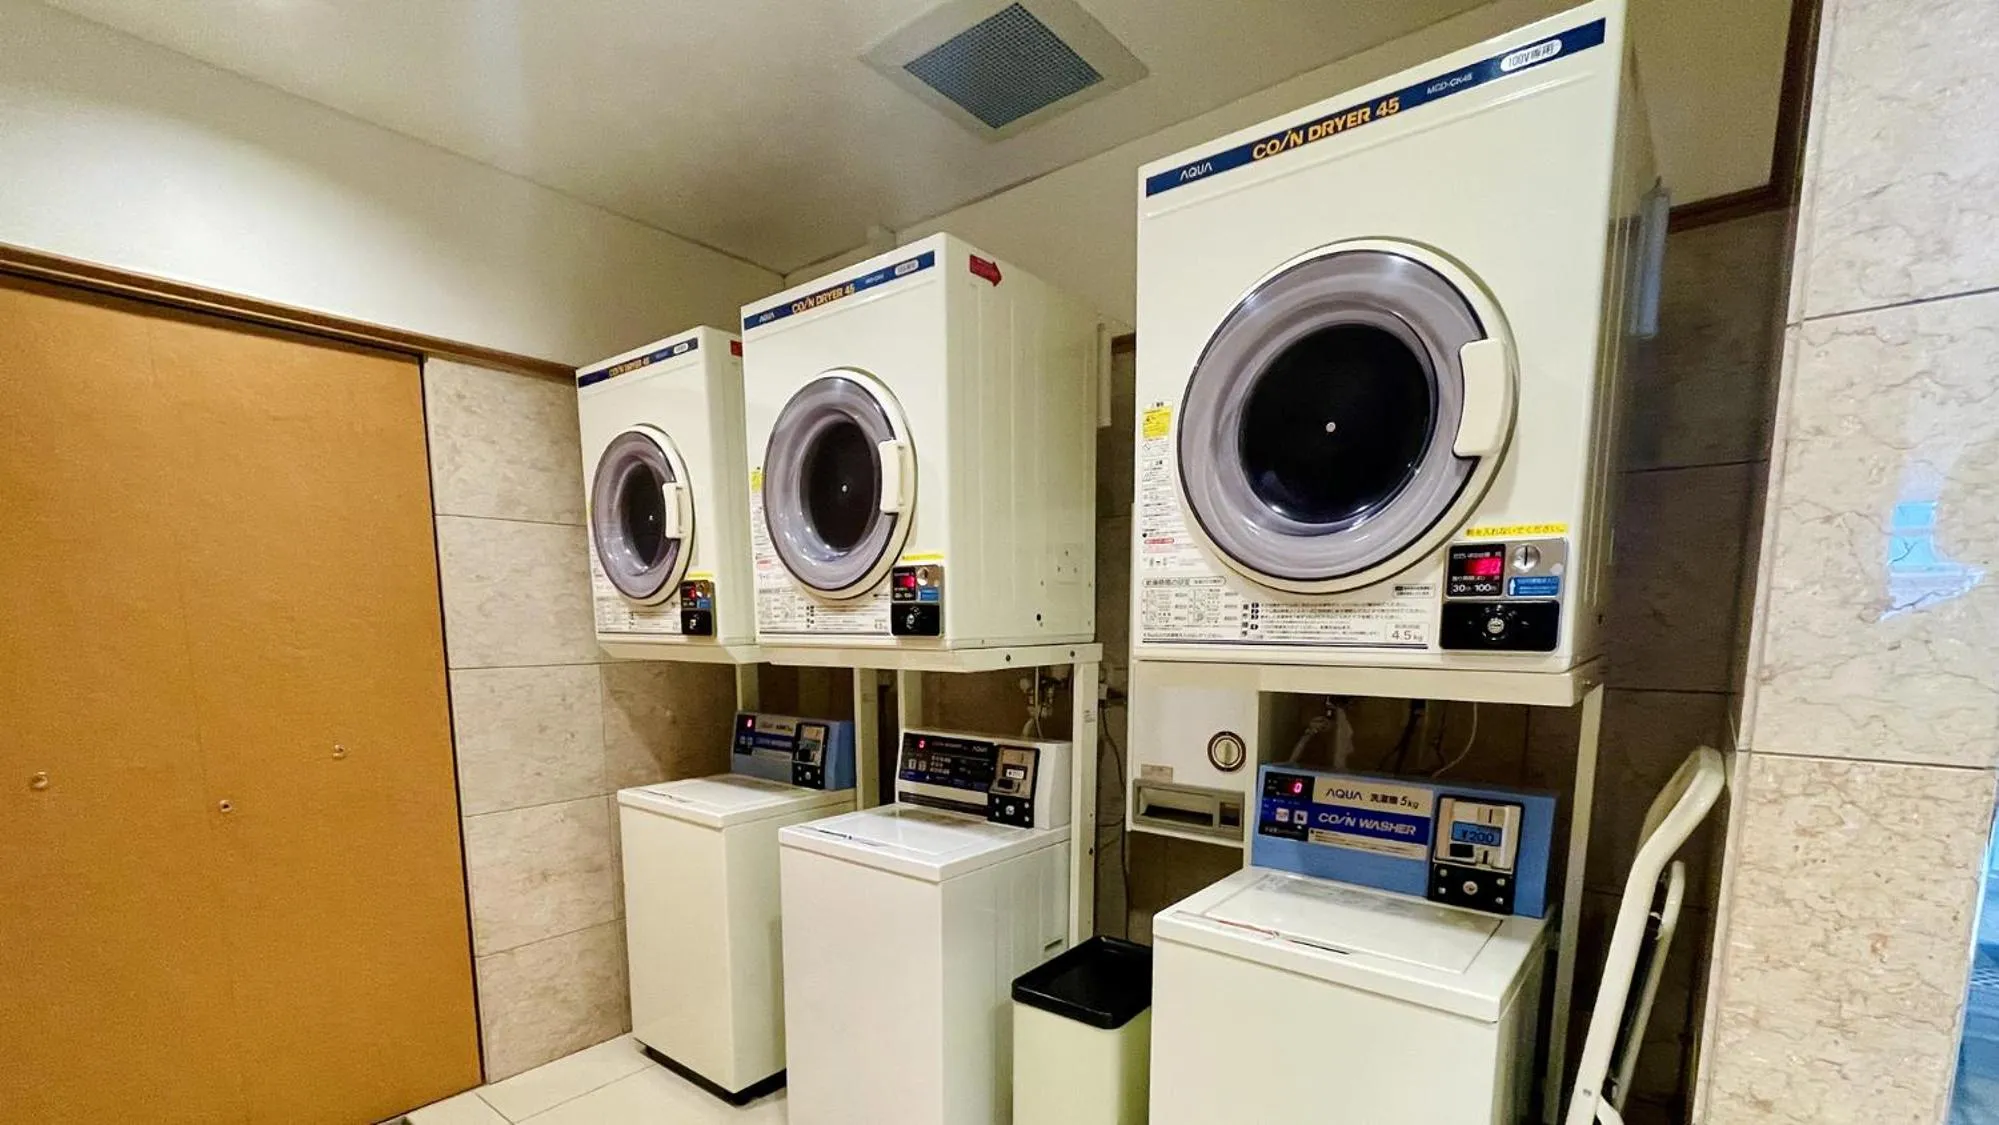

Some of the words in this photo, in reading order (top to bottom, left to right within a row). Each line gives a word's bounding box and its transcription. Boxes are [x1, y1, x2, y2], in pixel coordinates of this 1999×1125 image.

[1180, 162, 1214, 183] AQUA
[1307, 107, 1371, 142] DRYER
[1376, 97, 1400, 117] 45
[1293, 782, 1303, 793] 0
[1326, 788, 1362, 802] AQUA
[1359, 818, 1417, 836] WASHER
[1462, 829, 1495, 844] ¥200
